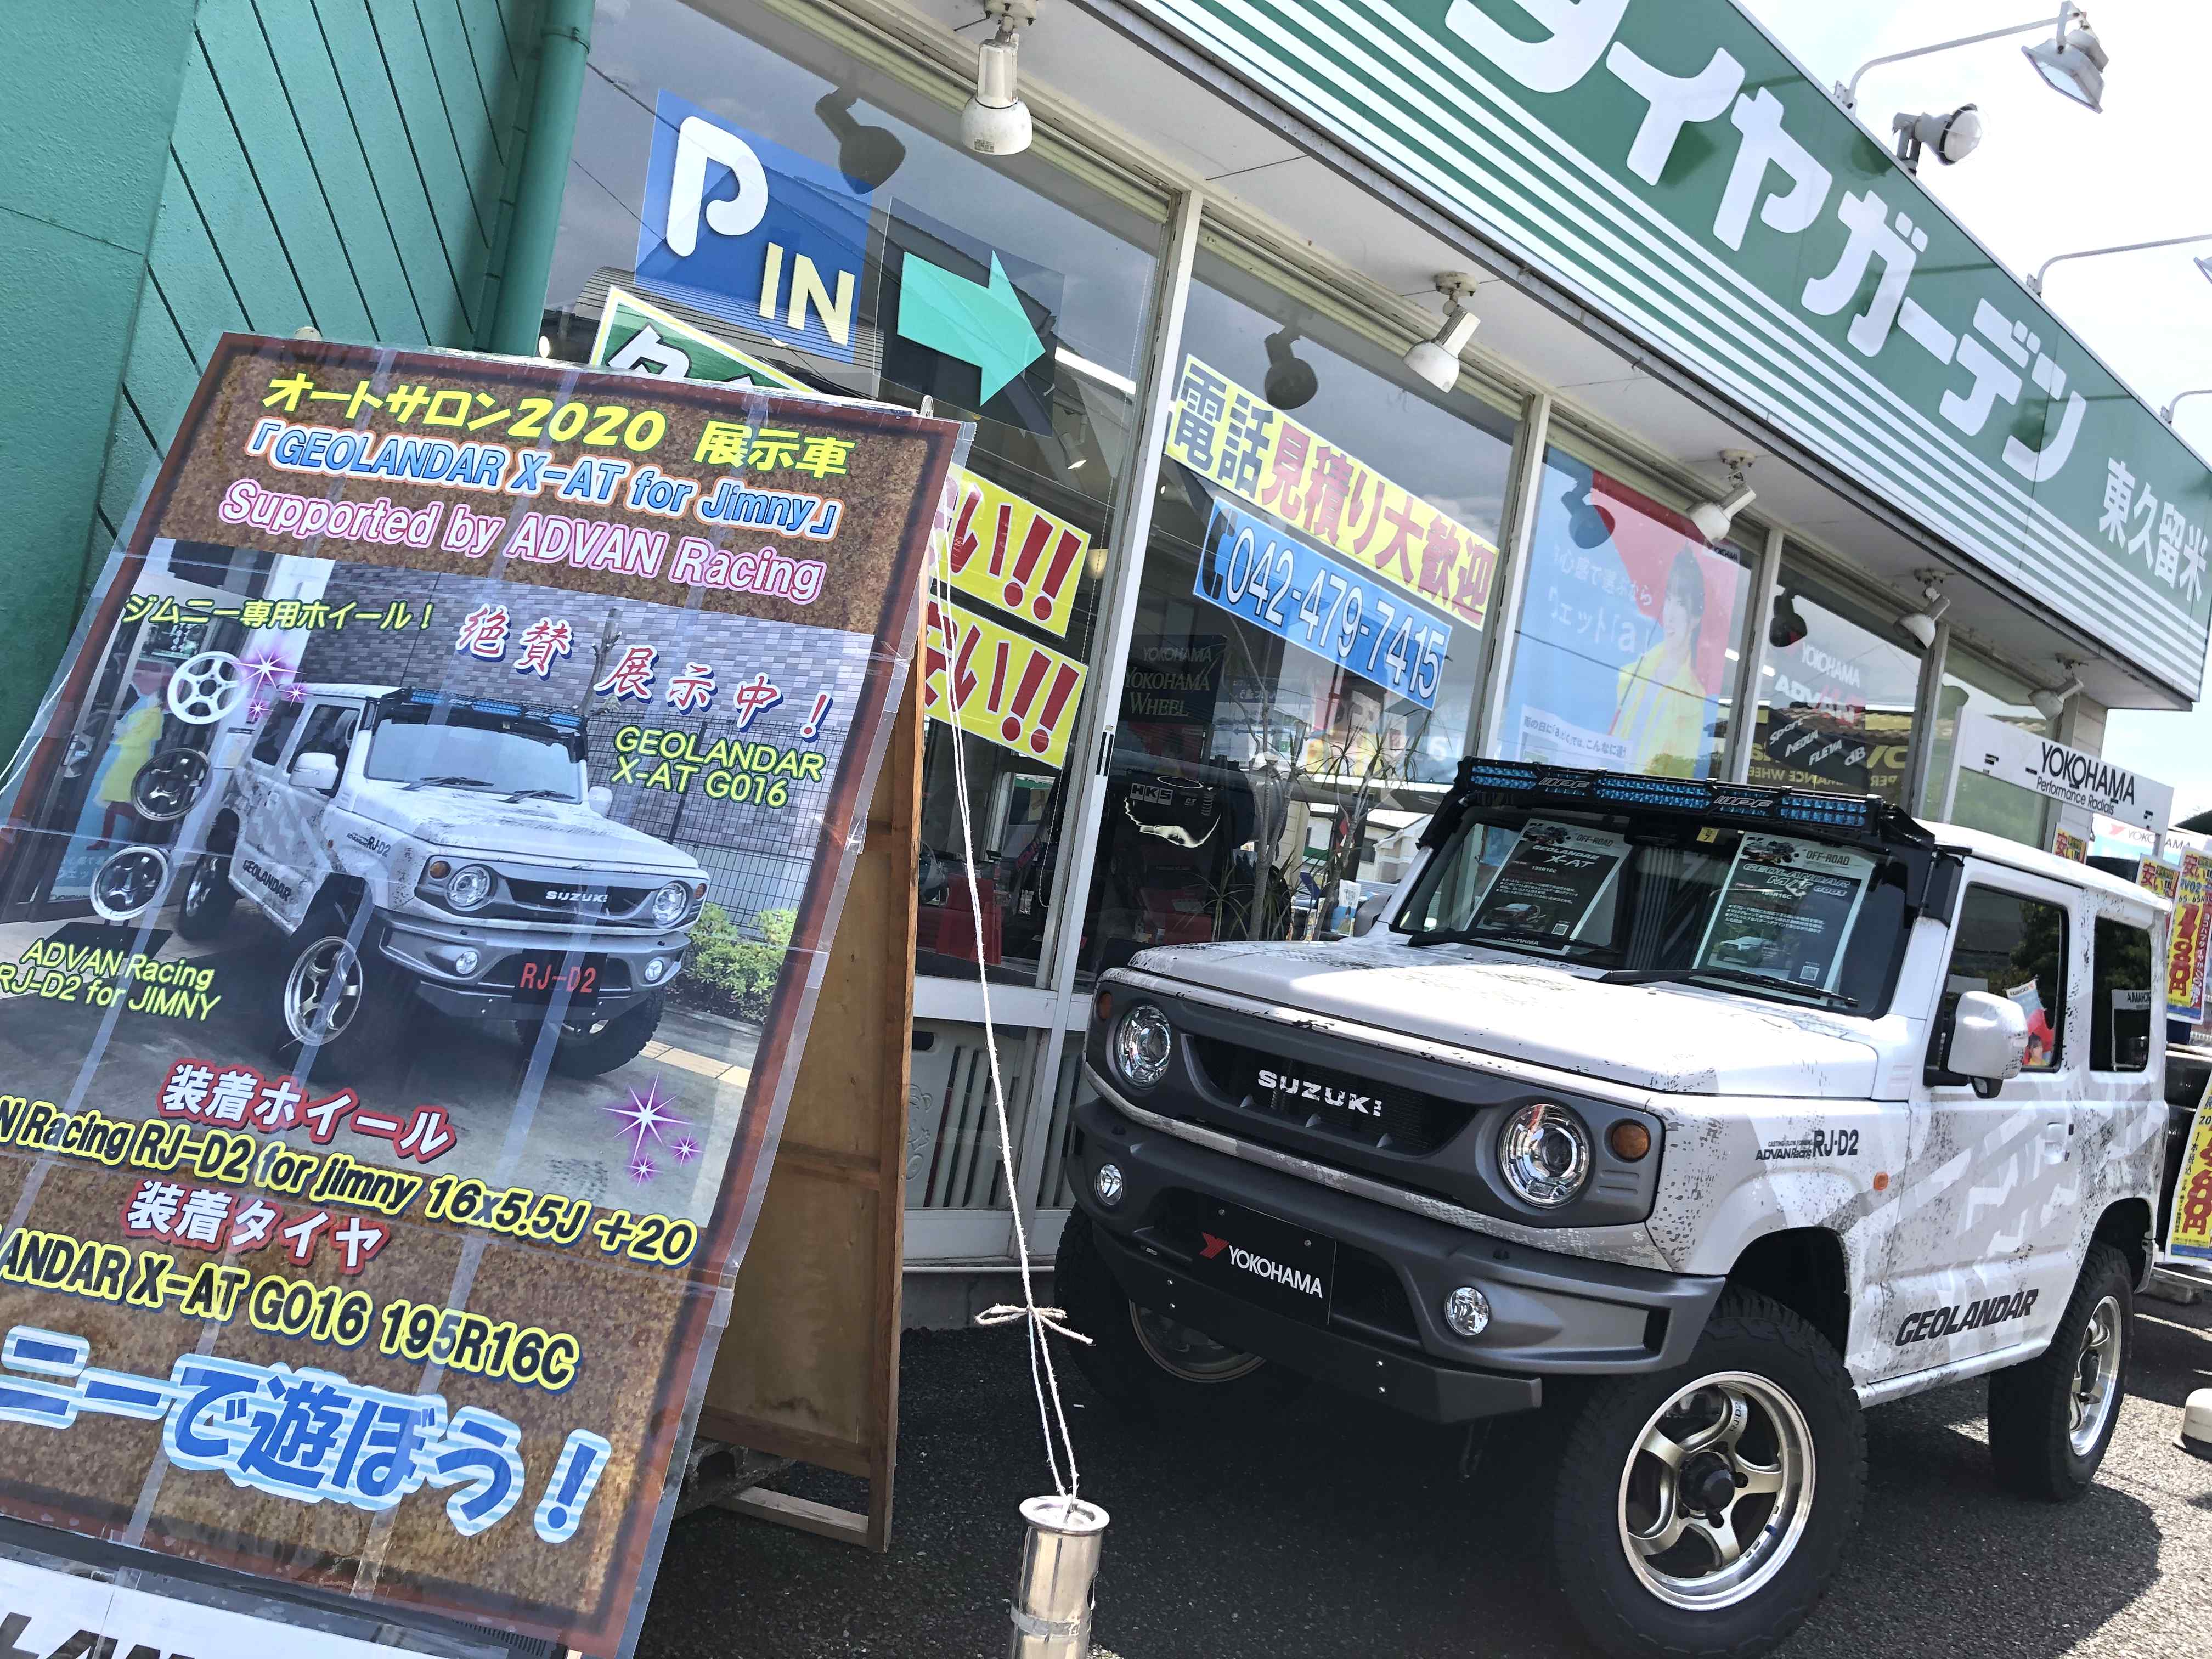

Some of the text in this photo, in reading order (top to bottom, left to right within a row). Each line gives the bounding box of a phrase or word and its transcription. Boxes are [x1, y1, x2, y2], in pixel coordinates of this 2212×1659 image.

[666, 116, 769, 257] P
[759, 241, 855, 346] IN
[262, 372, 857, 479] オートサロン2020 展示車
[510, 452, 627, 501] X-AT
[631, 469, 692, 515] for
[1173, 362, 1496, 624] 電話見積り大歓迎
[223, 482, 825, 603] Supported by ADVAN Racing
[2098, 457, 2208, 602] 東久留米
[1227, 527, 1446, 701] 042-479-7415
[1125, 667, 1210, 691] YOKOHAMA
[1143, 646, 1212, 662] YOKOHAMA
[613, 725, 826, 783] GEOLANDAR
[1809, 740, 1843, 766] FLEVA
[1844, 745, 1866, 766] dB
[2041, 742, 2135, 805] YOKOHAMA
[610, 757, 789, 808] X-AT G016
[1130, 783, 1173, 806] HKS
[2036, 776, 2114, 816] Performance Radials
[1532, 845, 1600, 860] GEOLANDAR
[1543, 854, 1596, 868] X-AT
[1576, 834, 1613, 847] OFF-ROAD
[1806, 850, 1850, 865] OFF-ROAD
[2128, 830, 2191, 850] YOKOAM
[242, 860, 292, 902] GEOLANDAR
[545, 889, 609, 904] SUZUKI
[1743, 863, 1851, 889] GEOLANDAR
[19, 937, 216, 991] ADVAN Racing
[520, 961, 597, 994] RJ-D2
[0, 962, 222, 1022] RJ-D2 for JIMNY
[161, 1063, 453, 1156] 装着ホイール
[1257, 1069, 1383, 1117] SUZUKI
[1755, 1148, 1791, 1160] ADVAN
[1812, 1129, 1859, 1158] RJ-D2
[20, 1104, 132, 1161] Racing
[138, 1124, 252, 1182] RJ-D2
[258, 1144, 315, 1191] for
[595, 1214, 697, 1262] +20
[126, 1181, 383, 1267] 装着タイヤ
[1228, 1245, 1323, 1299] YOKOHAMA
[127, 1253, 245, 1319] X-AT
[254, 1283, 369, 1342] G016
[384, 1302, 579, 1385] 195R16C
[1895, 1289, 2039, 1346] GEOLANDAR
